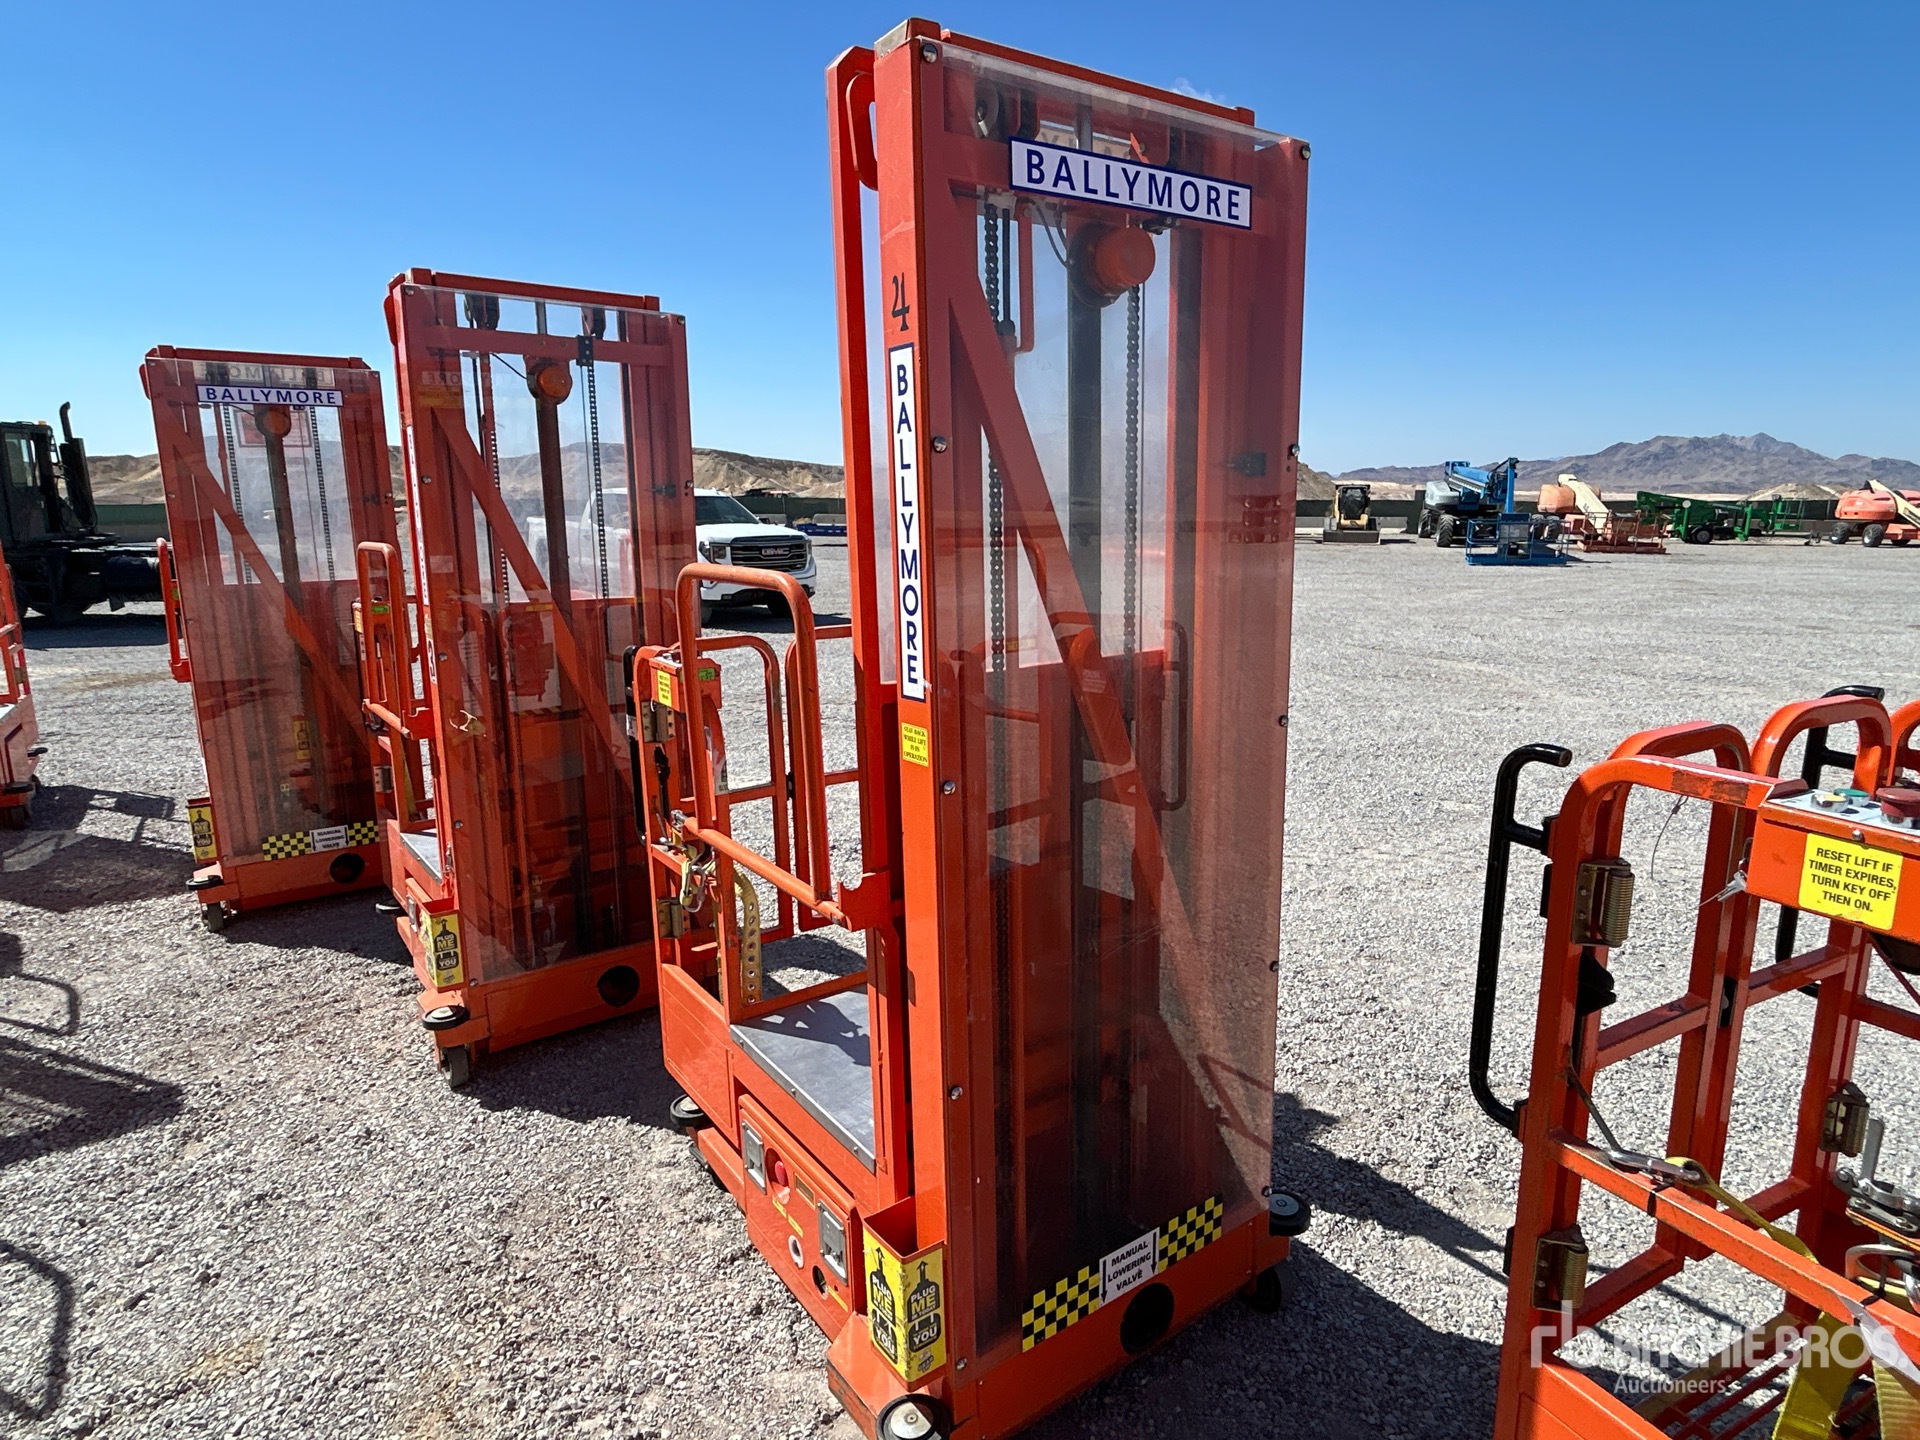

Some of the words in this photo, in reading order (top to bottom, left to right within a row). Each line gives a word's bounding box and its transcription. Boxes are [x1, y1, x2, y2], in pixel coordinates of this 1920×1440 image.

[1026, 148, 1241, 221] BALLYMORE
[891, 272, 910, 332] 4
[205, 387, 337, 404] BALLYMORE
[896, 363, 919, 685] BALLYMORE
[1816, 847, 1852, 863] RESET
[1854, 856, 1880, 870] LIFT
[1881, 862, 1894, 873] IF
[1809, 859, 1842, 876] TIMER
[1845, 868, 1896, 890] EXPIRES,
[1811, 873, 1840, 889] TURN
[1843, 881, 1866, 895] KEY
[1868, 888, 1891, 901] OFF
[1822, 890, 1851, 906] THEN
[1854, 898, 1873, 912] ON.
[437, 940, 455, 949] ME
[439, 958, 457, 968] YOU
[1111, 1241, 1149, 1267] MANUAL
[1107, 1252, 1152, 1283] LOWERING
[1116, 1269, 1143, 1292] VALVE
[871, 1274, 892, 1299] PLUG
[872, 1284, 893, 1315] ME
[910, 1284, 936, 1303] PLUG
[911, 1293, 936, 1315] ME
[875, 1326, 895, 1354] YOU
[913, 1326, 938, 1345] YOU
